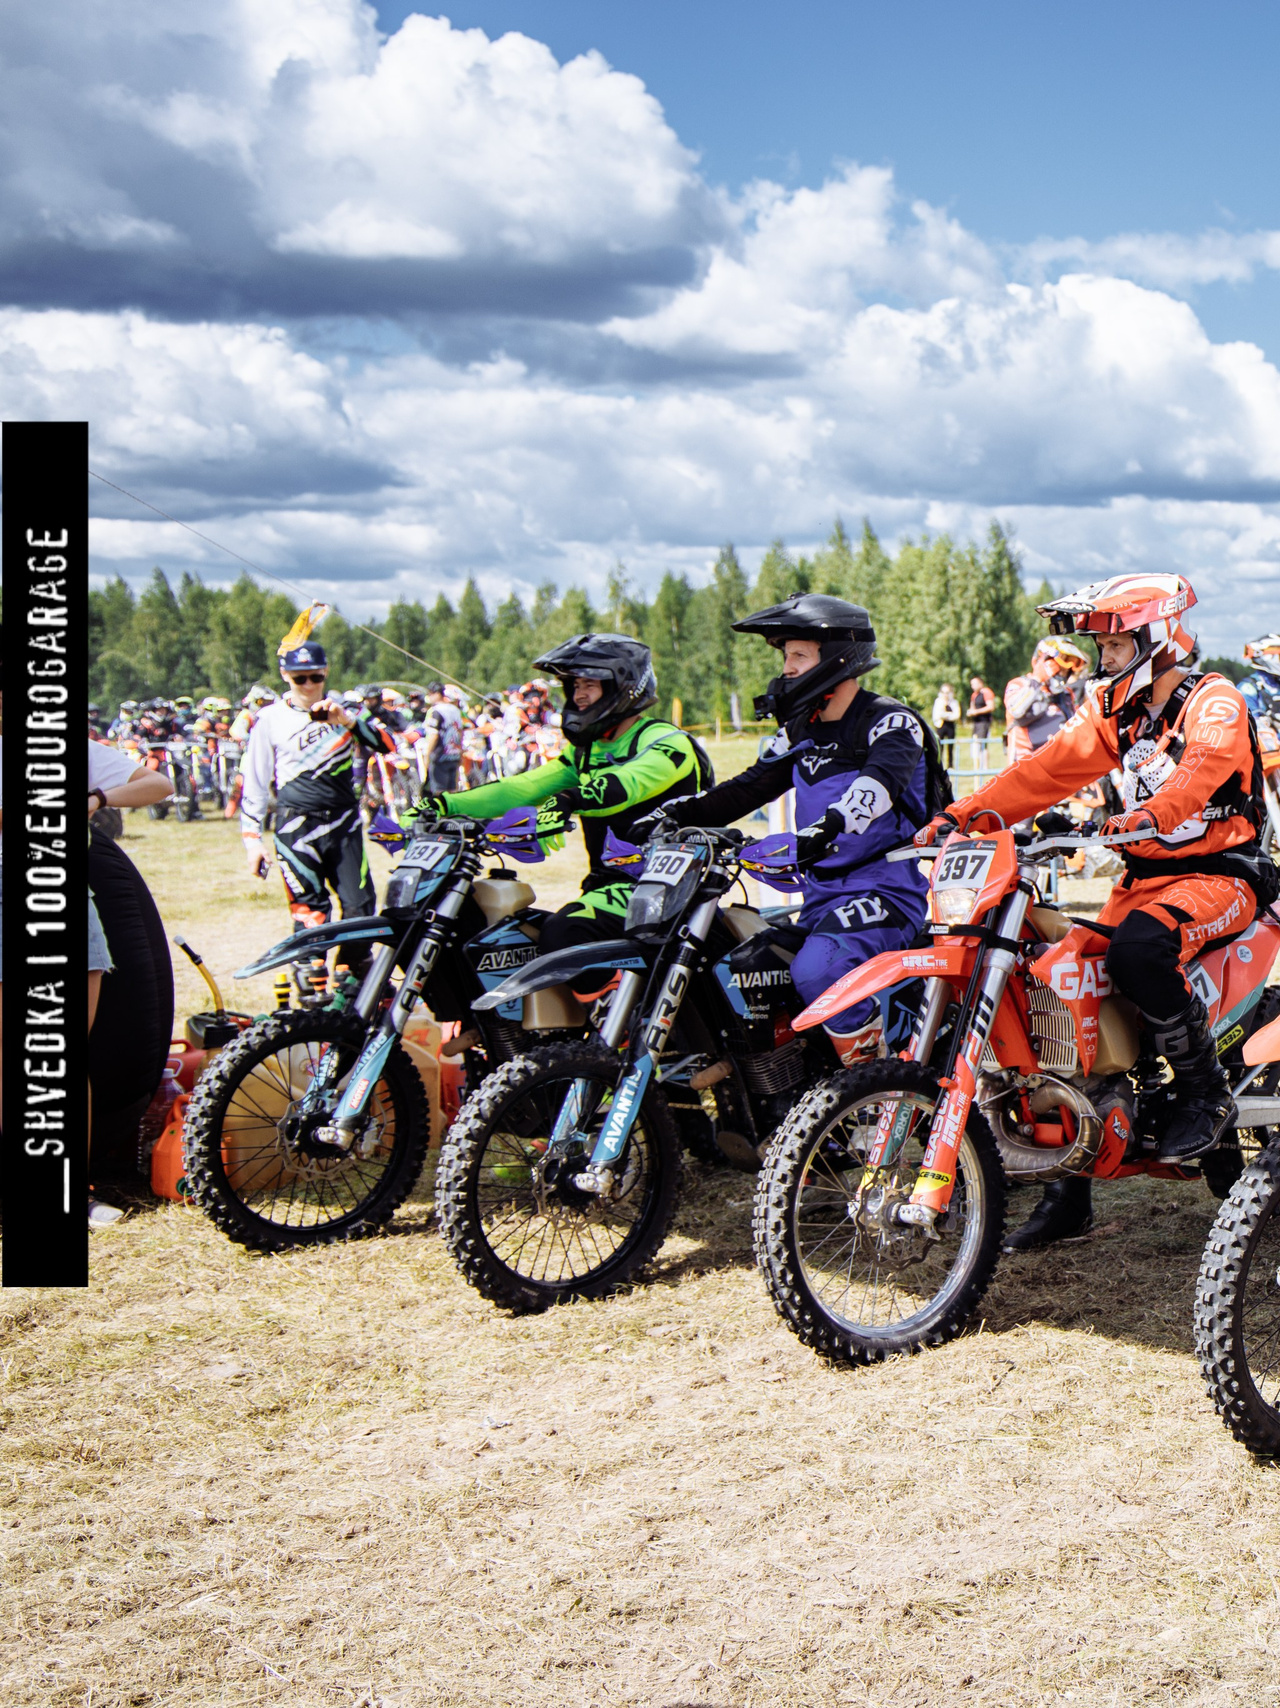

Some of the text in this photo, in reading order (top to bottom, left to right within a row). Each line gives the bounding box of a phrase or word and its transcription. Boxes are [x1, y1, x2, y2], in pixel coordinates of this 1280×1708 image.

[938, 854, 989, 882] 397
[610, 959, 640, 968] AVANTIS
[727, 969, 793, 989] AVANTIS
[744, 1003, 771, 1012] Limited
[742, 1011, 770, 1020] Edition
[602, 1069, 643, 1153] AVANTIS
